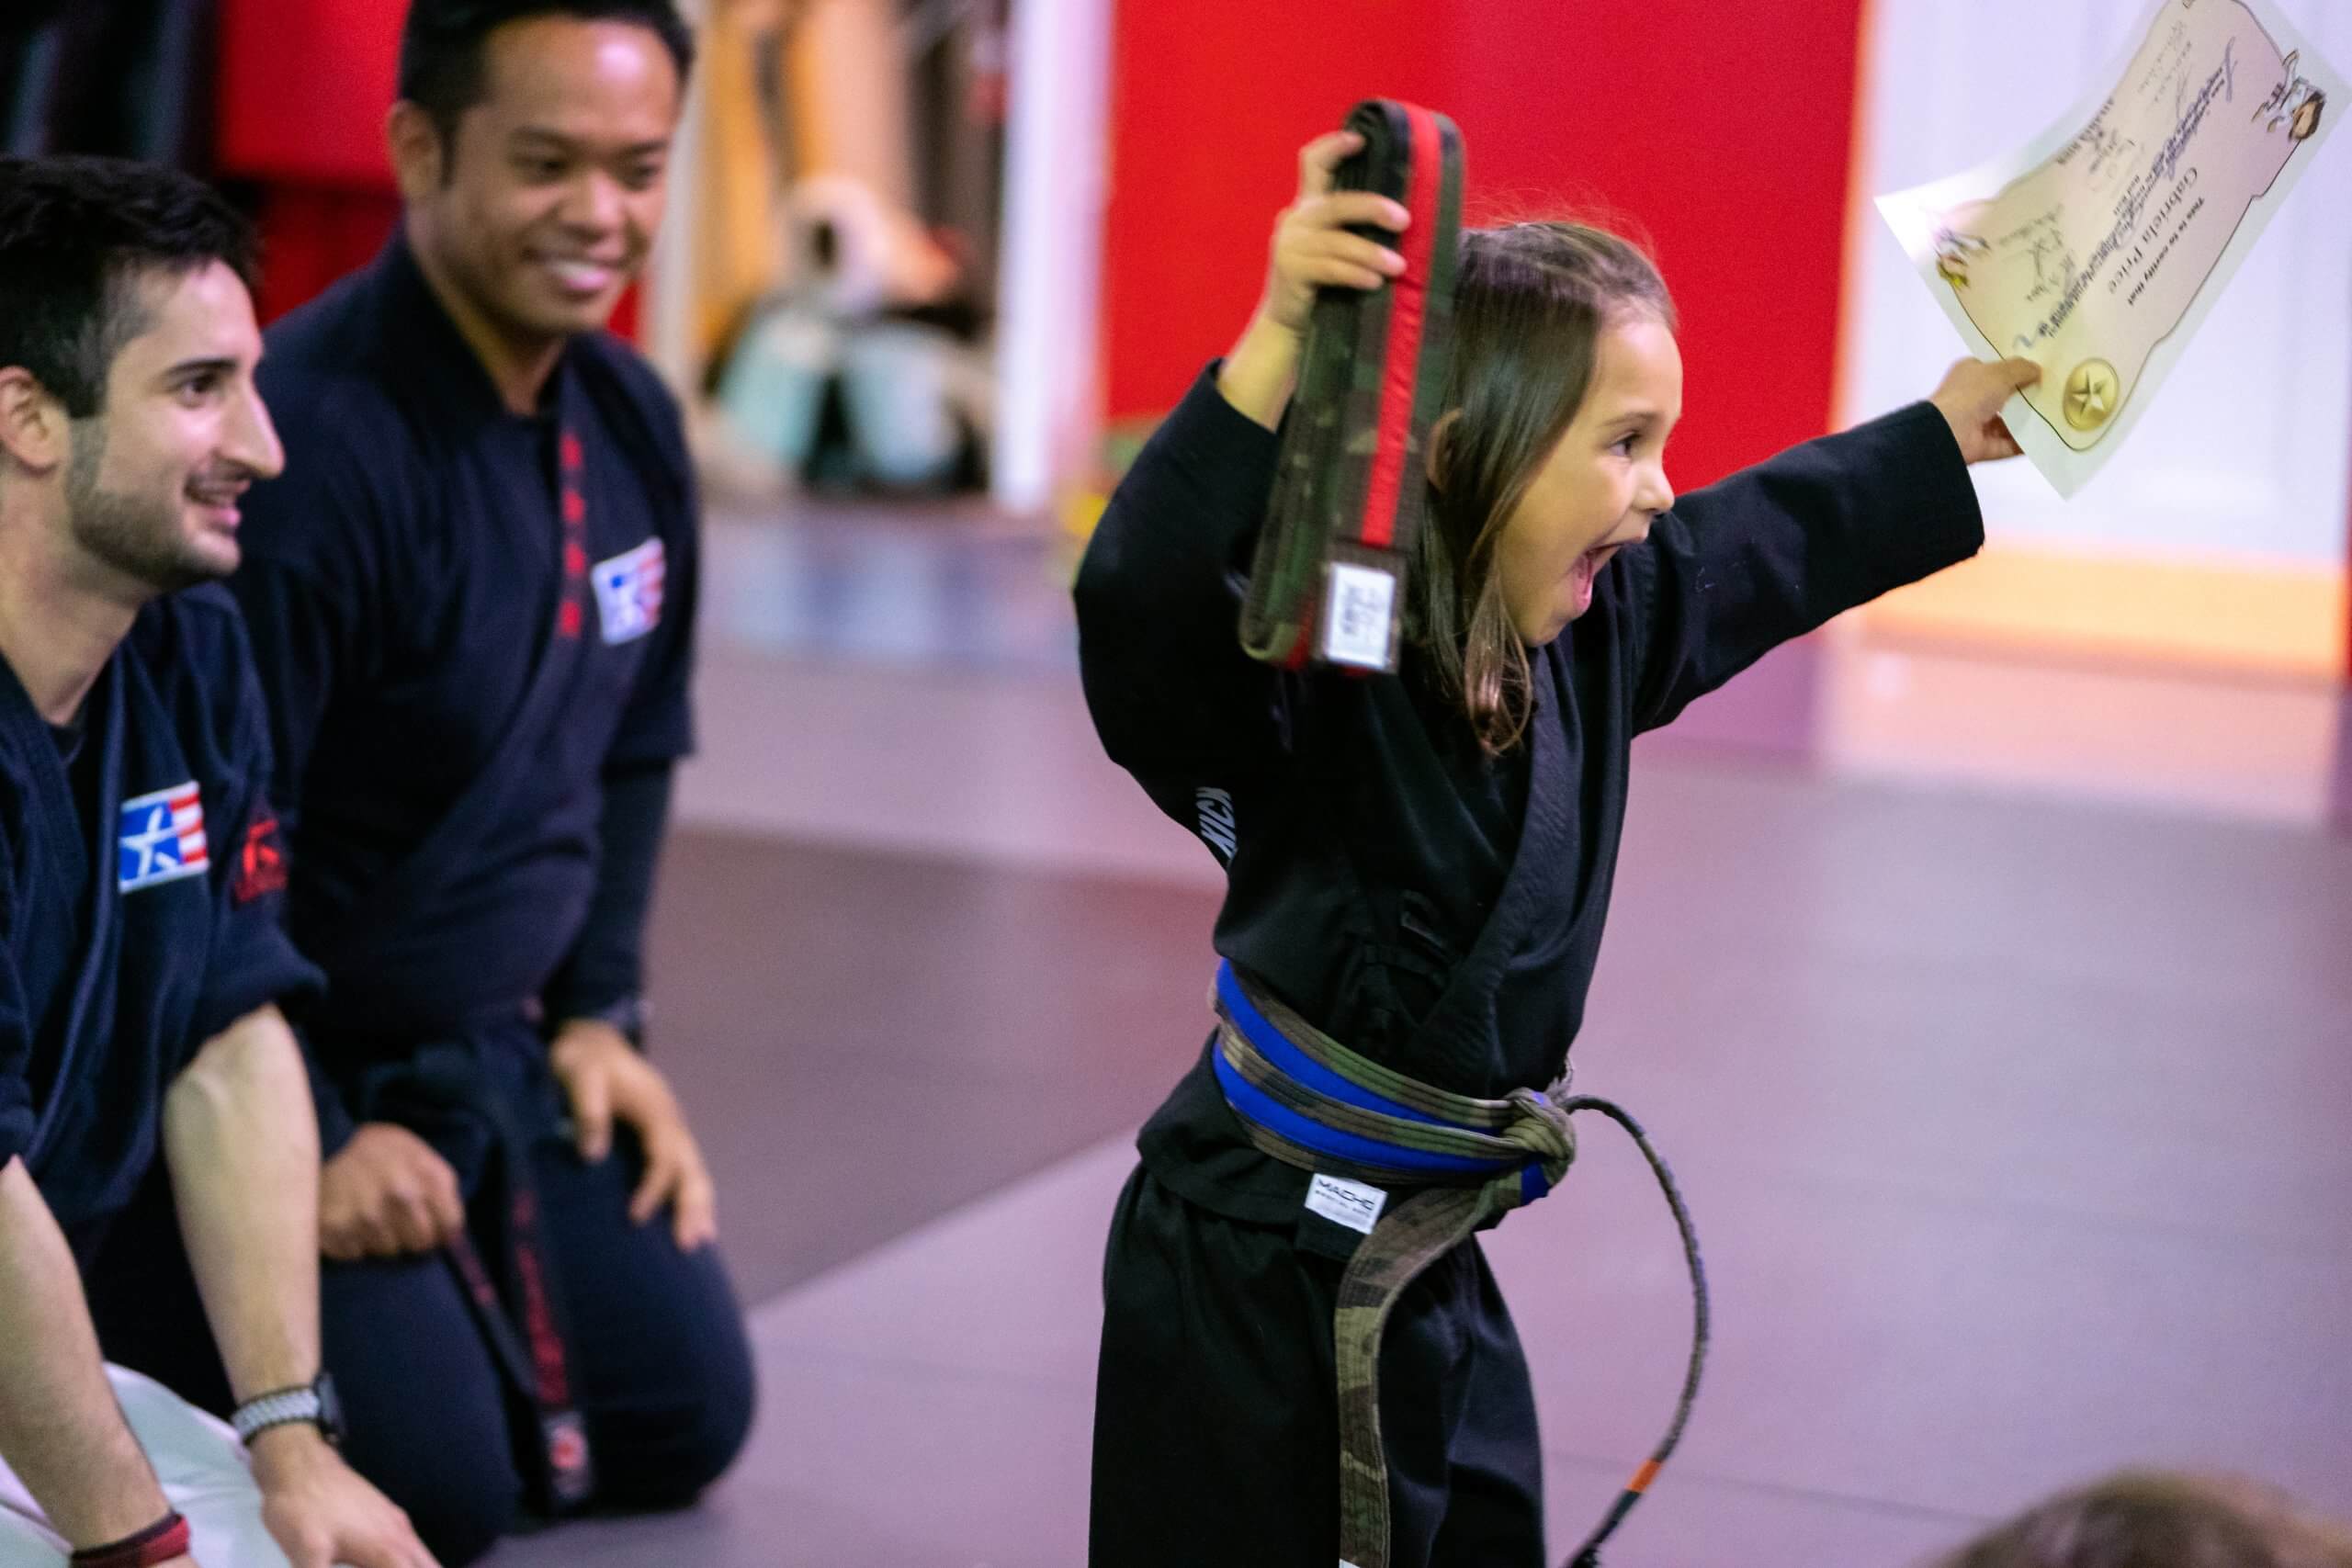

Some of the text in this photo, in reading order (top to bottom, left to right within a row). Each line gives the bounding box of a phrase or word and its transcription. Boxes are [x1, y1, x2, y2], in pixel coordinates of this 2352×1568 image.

[2142, 167, 2197, 243] Gabriela
[2186, 197, 2204, 220] This
[2108, 245, 2143, 293] Price
[2127, 281, 2144, 306] that
